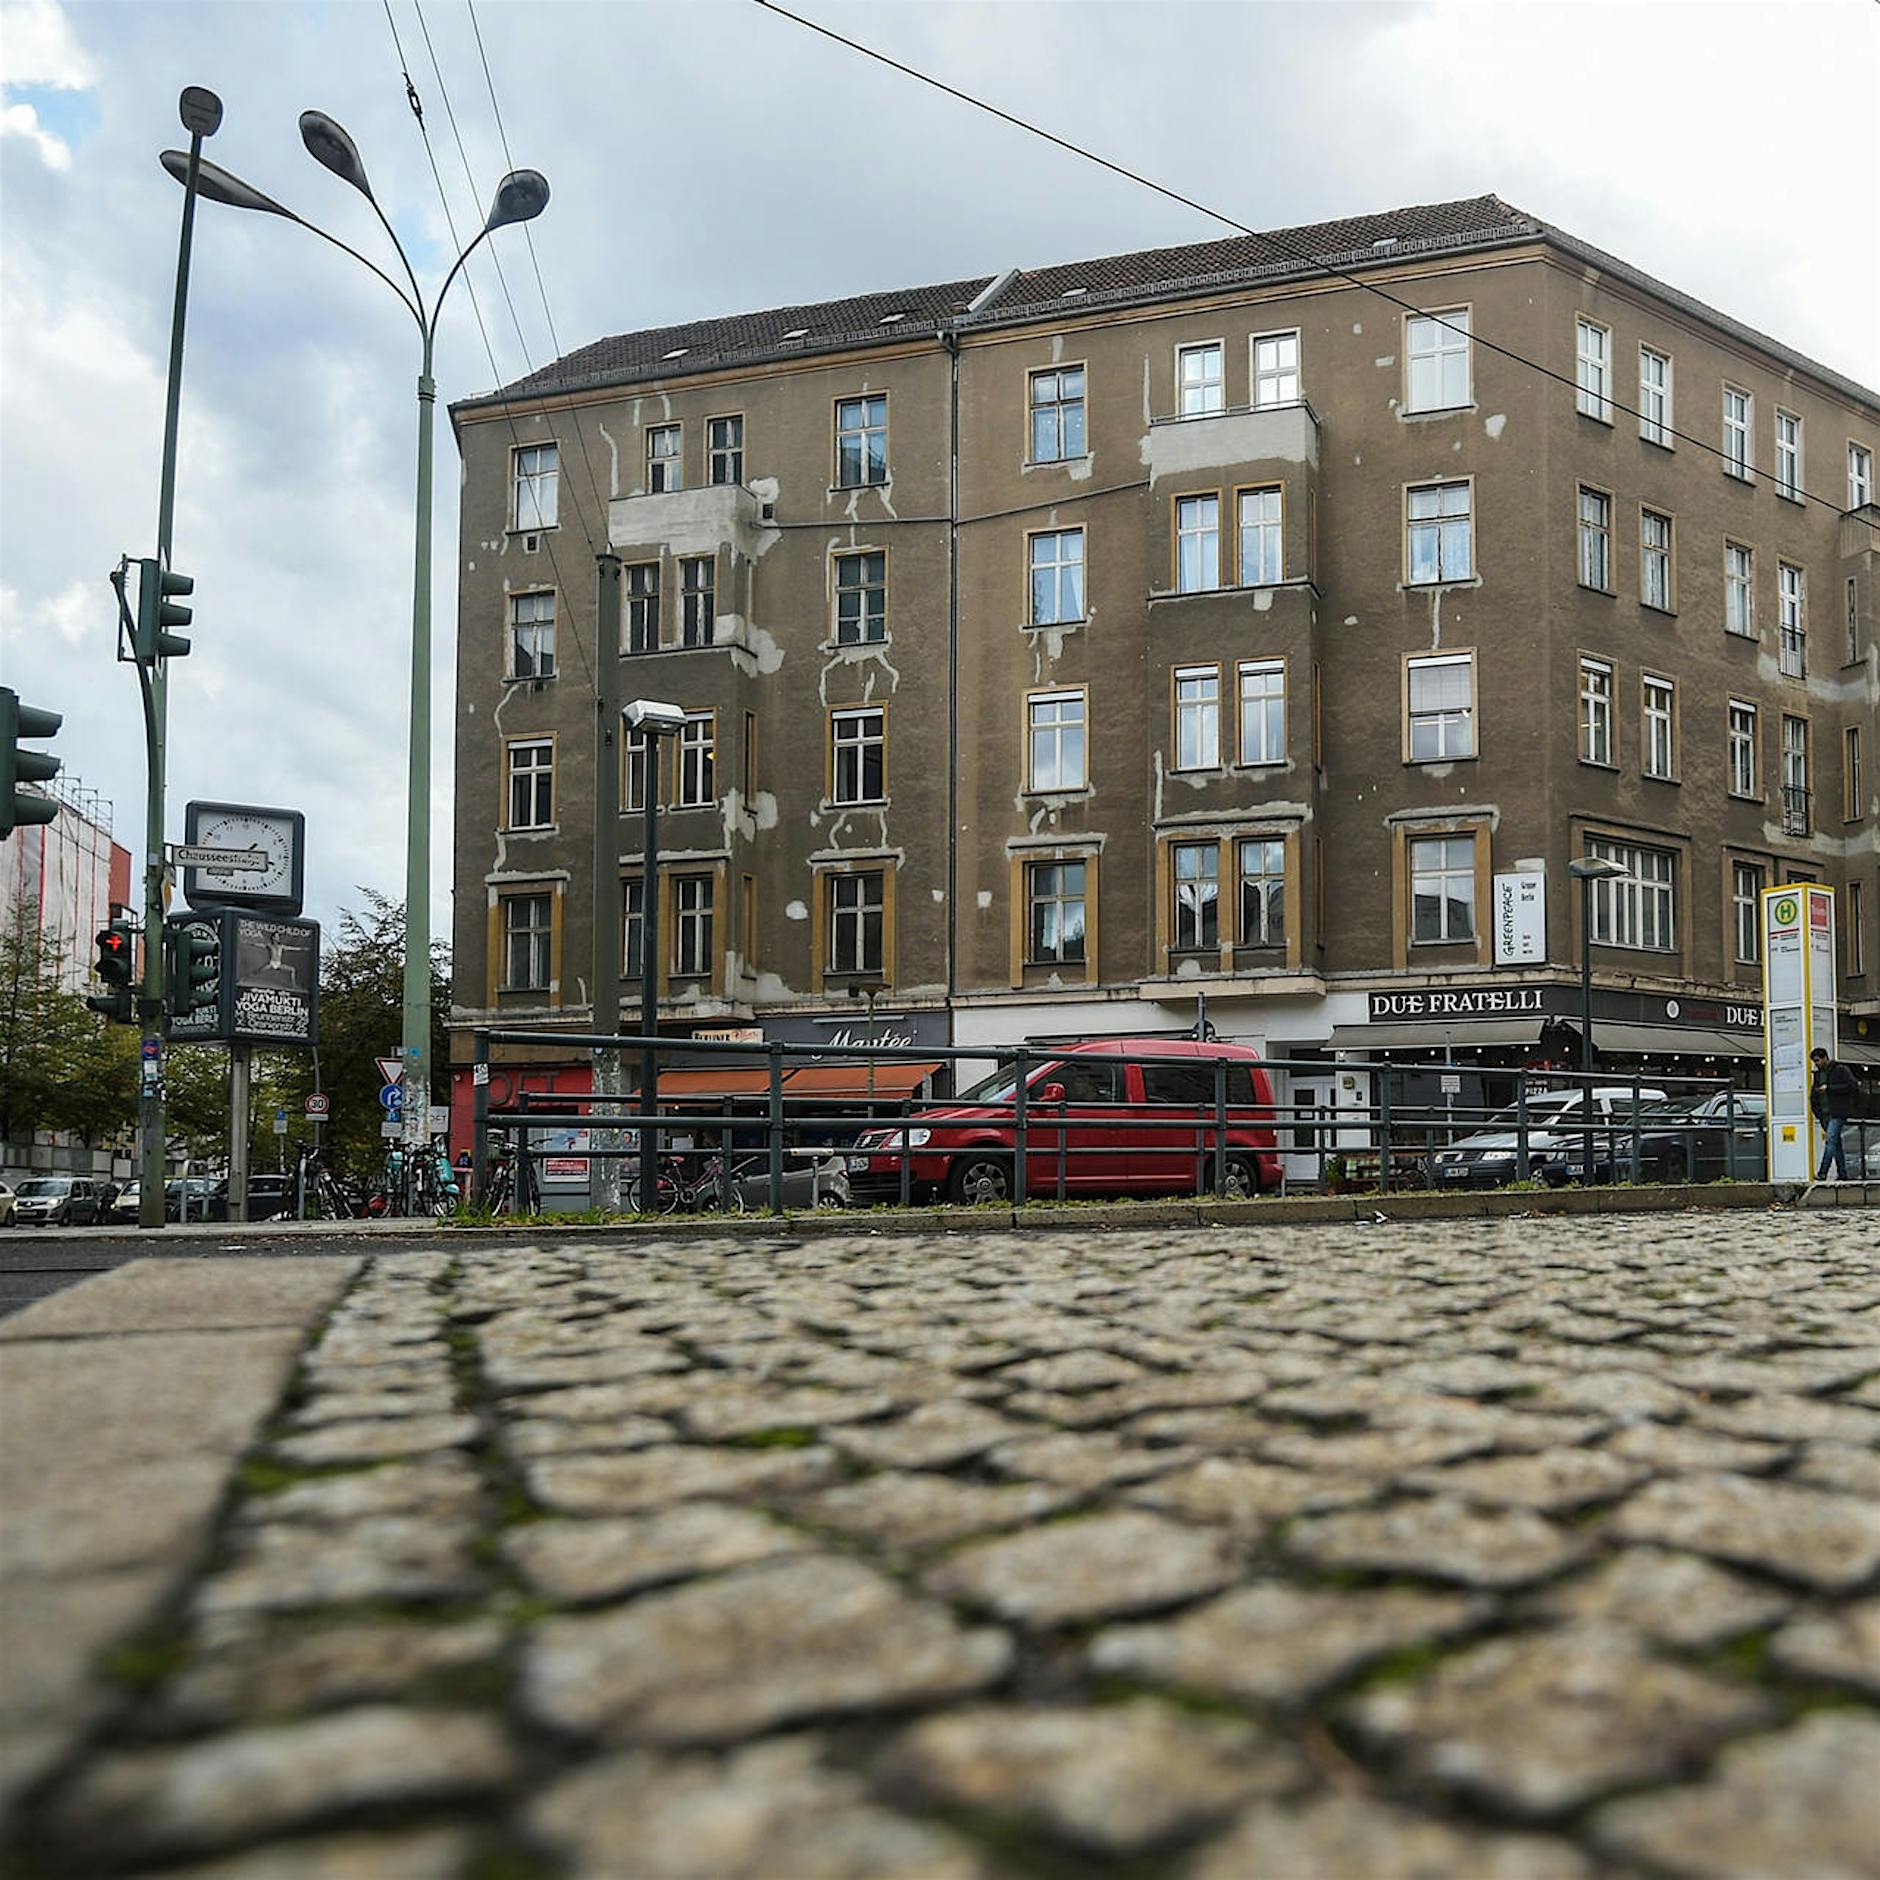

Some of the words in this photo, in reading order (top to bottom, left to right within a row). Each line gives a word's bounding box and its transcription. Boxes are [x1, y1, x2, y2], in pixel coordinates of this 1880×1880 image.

[1502, 883, 1515, 956] GREENPEACE
[240, 991, 302, 1007] JIVAMUKTI
[1373, 995, 1425, 1015] DUE
[1428, 990, 1543, 1013] FRATELLI
[236, 1000, 268, 1013] YOGA
[269, 1004, 309, 1017] BERLIN
[1726, 1006, 1757, 1026] DUE
[312, 1099, 324, 1109] 30
